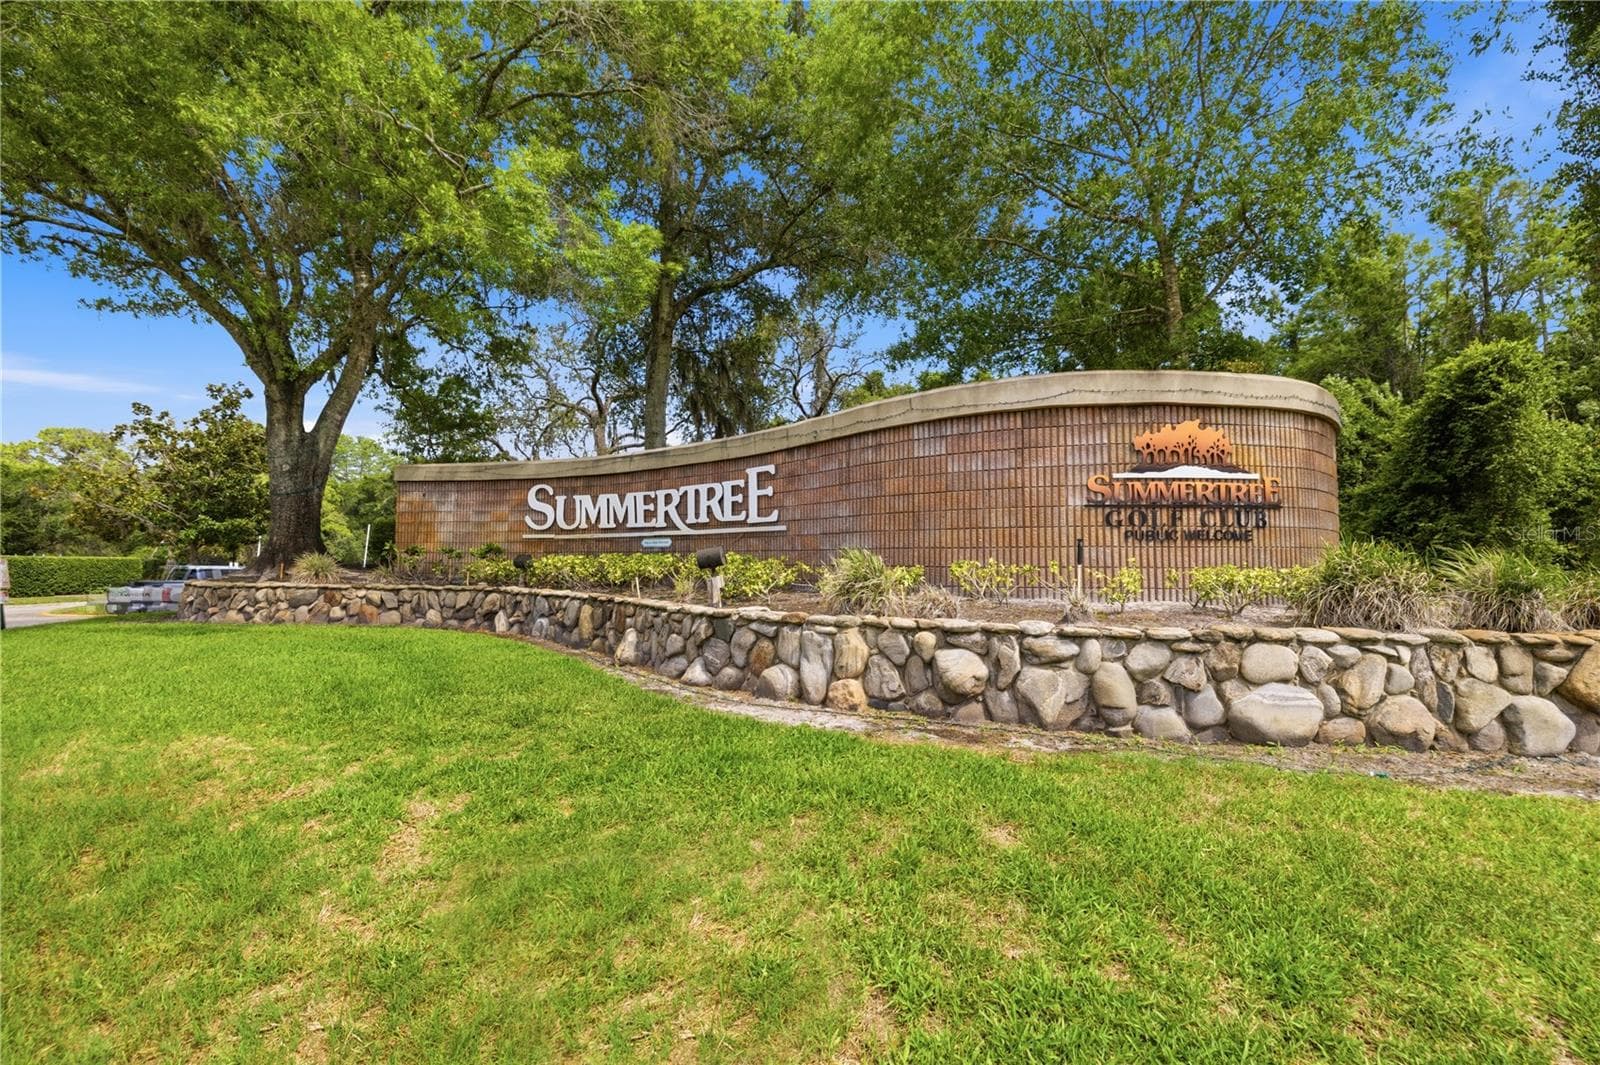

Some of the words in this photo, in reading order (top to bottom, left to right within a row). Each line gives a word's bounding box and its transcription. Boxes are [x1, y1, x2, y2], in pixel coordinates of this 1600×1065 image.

[524, 464, 779, 533] SUMMERTREE
[1087, 474, 1280, 505] SUMMERTREE
[1105, 509, 1183, 529] GOLF
[1201, 508, 1267, 529] CLUB
[1125, 529, 1178, 541] PUBLIC
[1184, 530, 1253, 541] WELCOME
